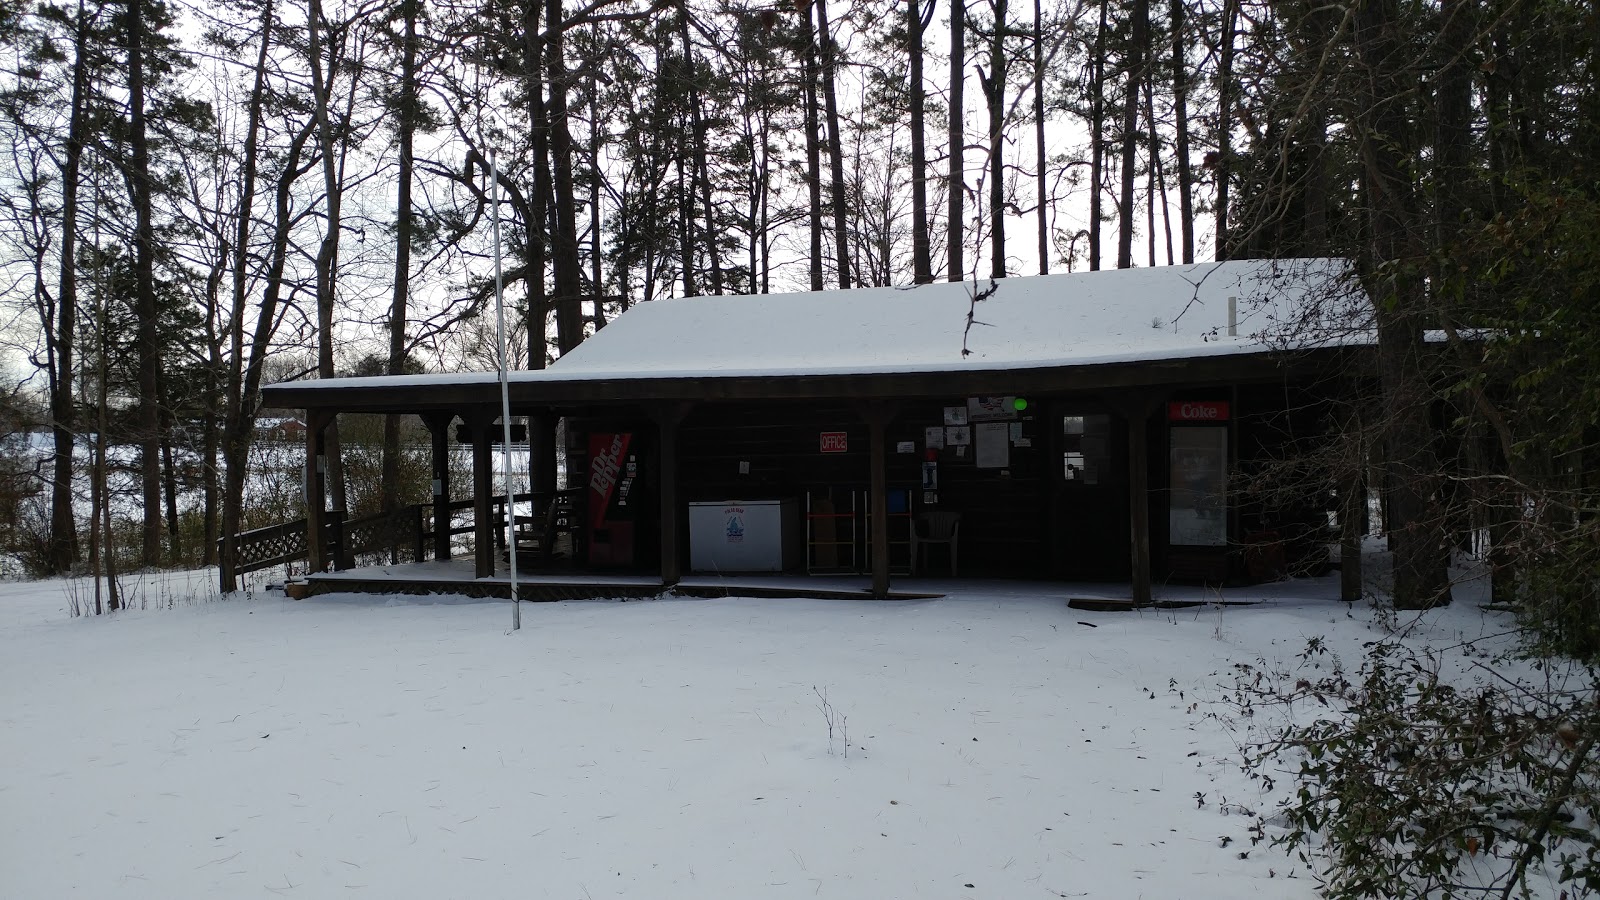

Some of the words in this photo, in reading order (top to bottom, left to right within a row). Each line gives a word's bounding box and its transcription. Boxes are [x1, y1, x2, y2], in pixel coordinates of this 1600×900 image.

[1181, 403, 1217, 418] Coke
[822, 435, 846, 449] OFFICE
[590, 434, 623, 498] Pepper
[591, 447, 608, 475] Dr
